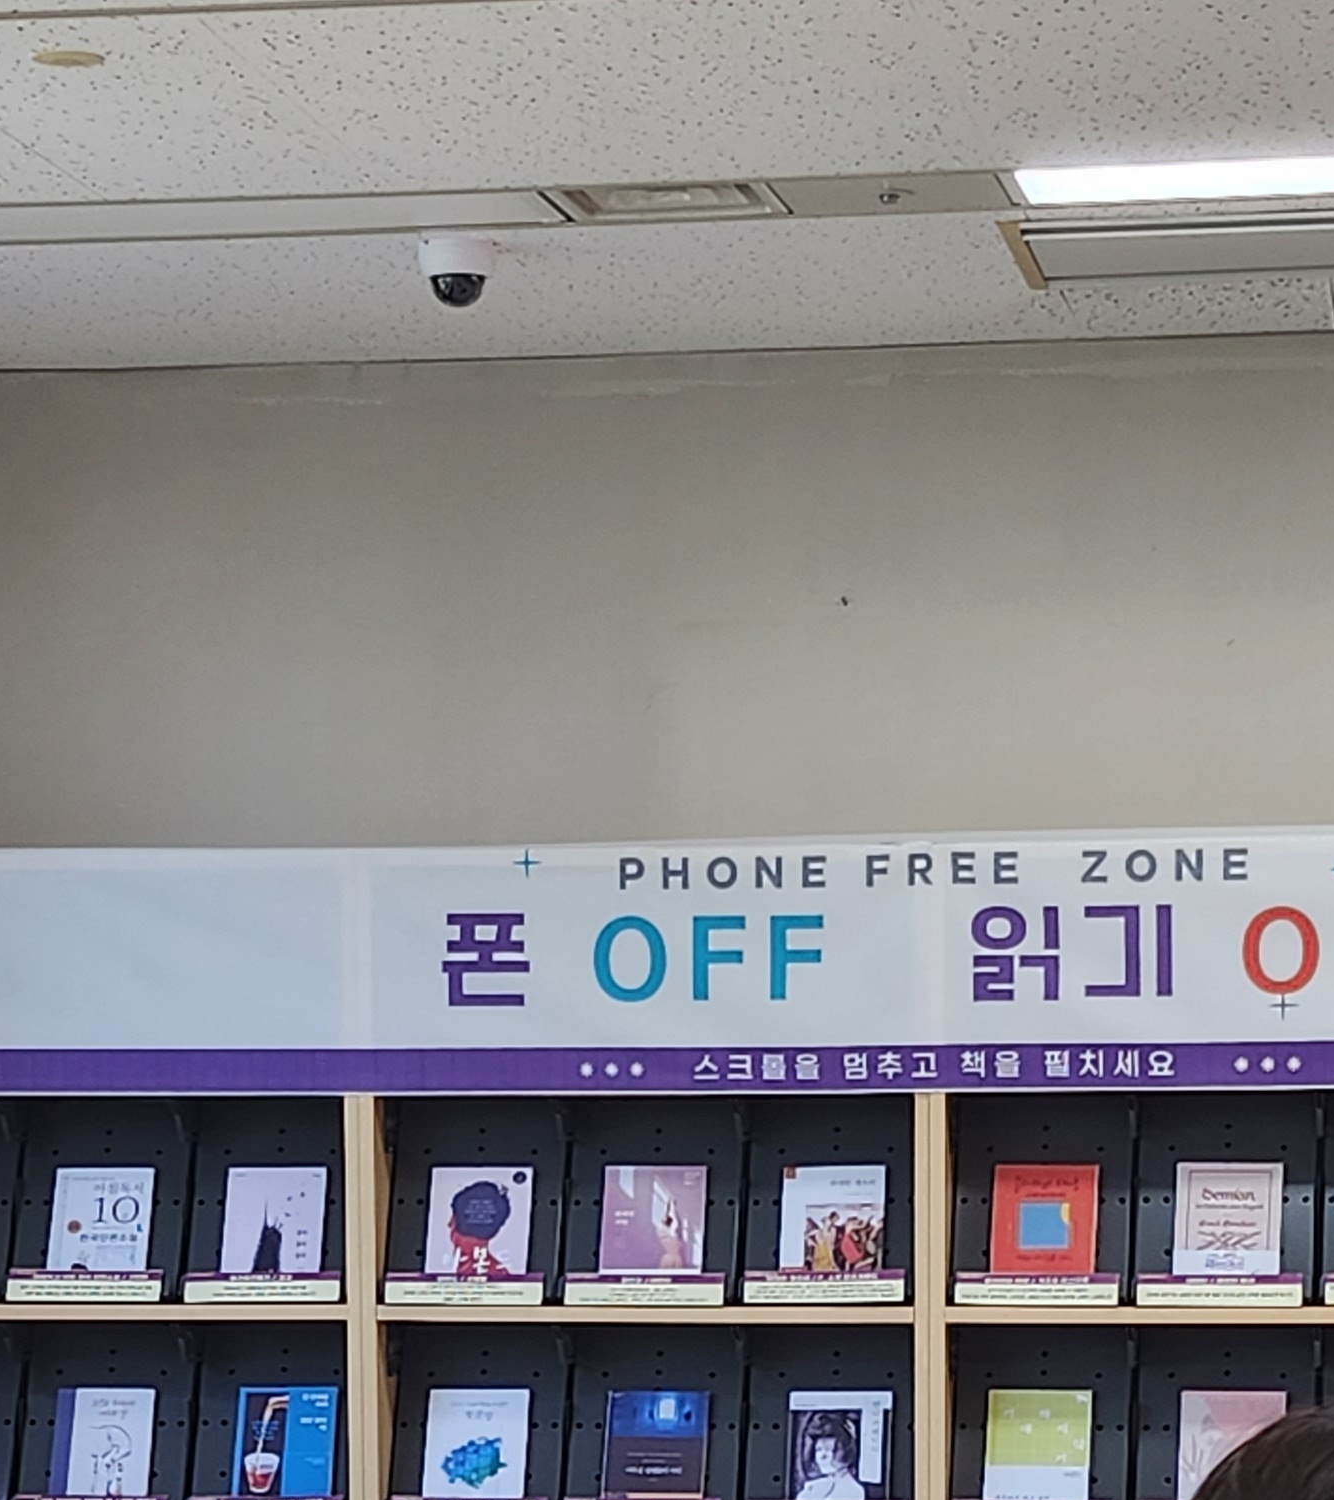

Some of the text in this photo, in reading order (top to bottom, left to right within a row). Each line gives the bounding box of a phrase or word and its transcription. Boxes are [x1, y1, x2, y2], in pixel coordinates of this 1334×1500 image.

[617, 846, 1251, 891] PHONE FREE ZONE
[440, 911, 532, 1008] 폰
[591, 913, 826, 1004] OFF
[969, 903, 1175, 1003] 읽기
[690, 1053, 822, 1082] 스크롤을
[841, 1051, 940, 1081] 멈추고
[959, 1049, 1023, 1079] 책을
[93, 1195, 140, 1224] 10
